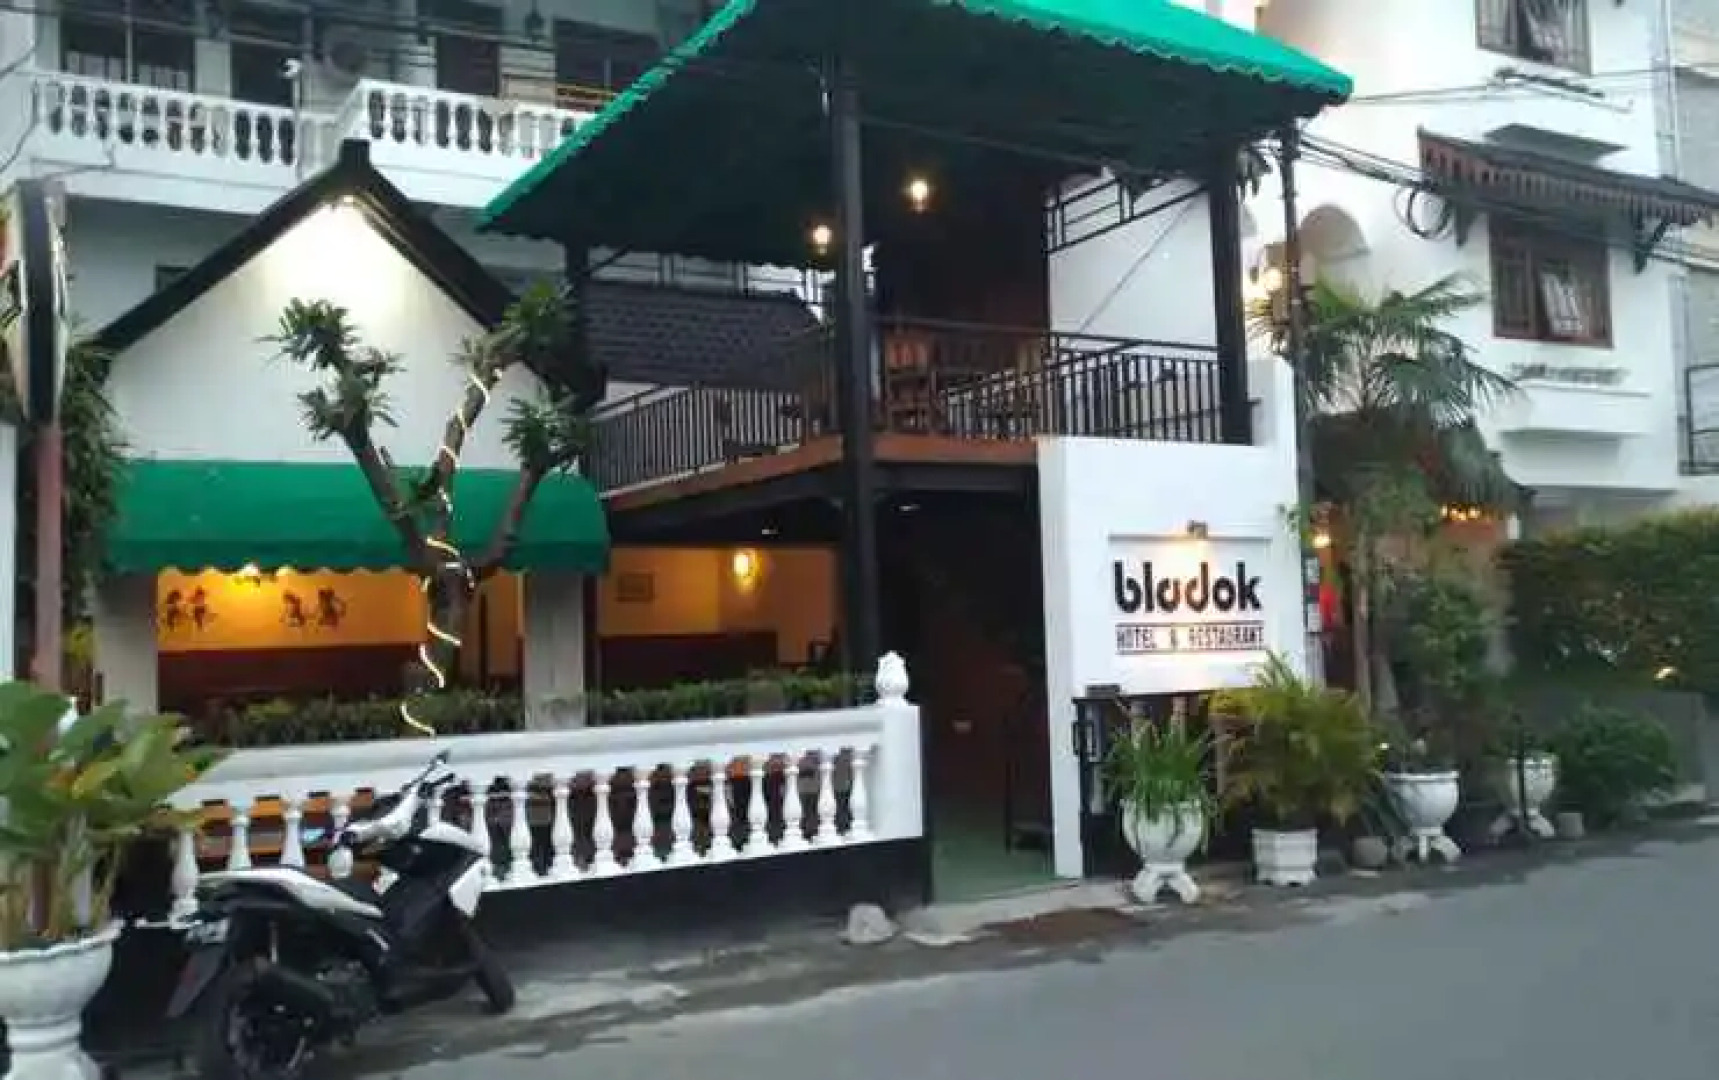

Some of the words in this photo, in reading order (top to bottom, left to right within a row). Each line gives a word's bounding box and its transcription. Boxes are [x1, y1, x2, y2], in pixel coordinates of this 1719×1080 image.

[1114, 561, 1262, 613] bladok
[1116, 626, 1157, 649] HOTEL
[1189, 625, 1265, 649] RESTAURANT
